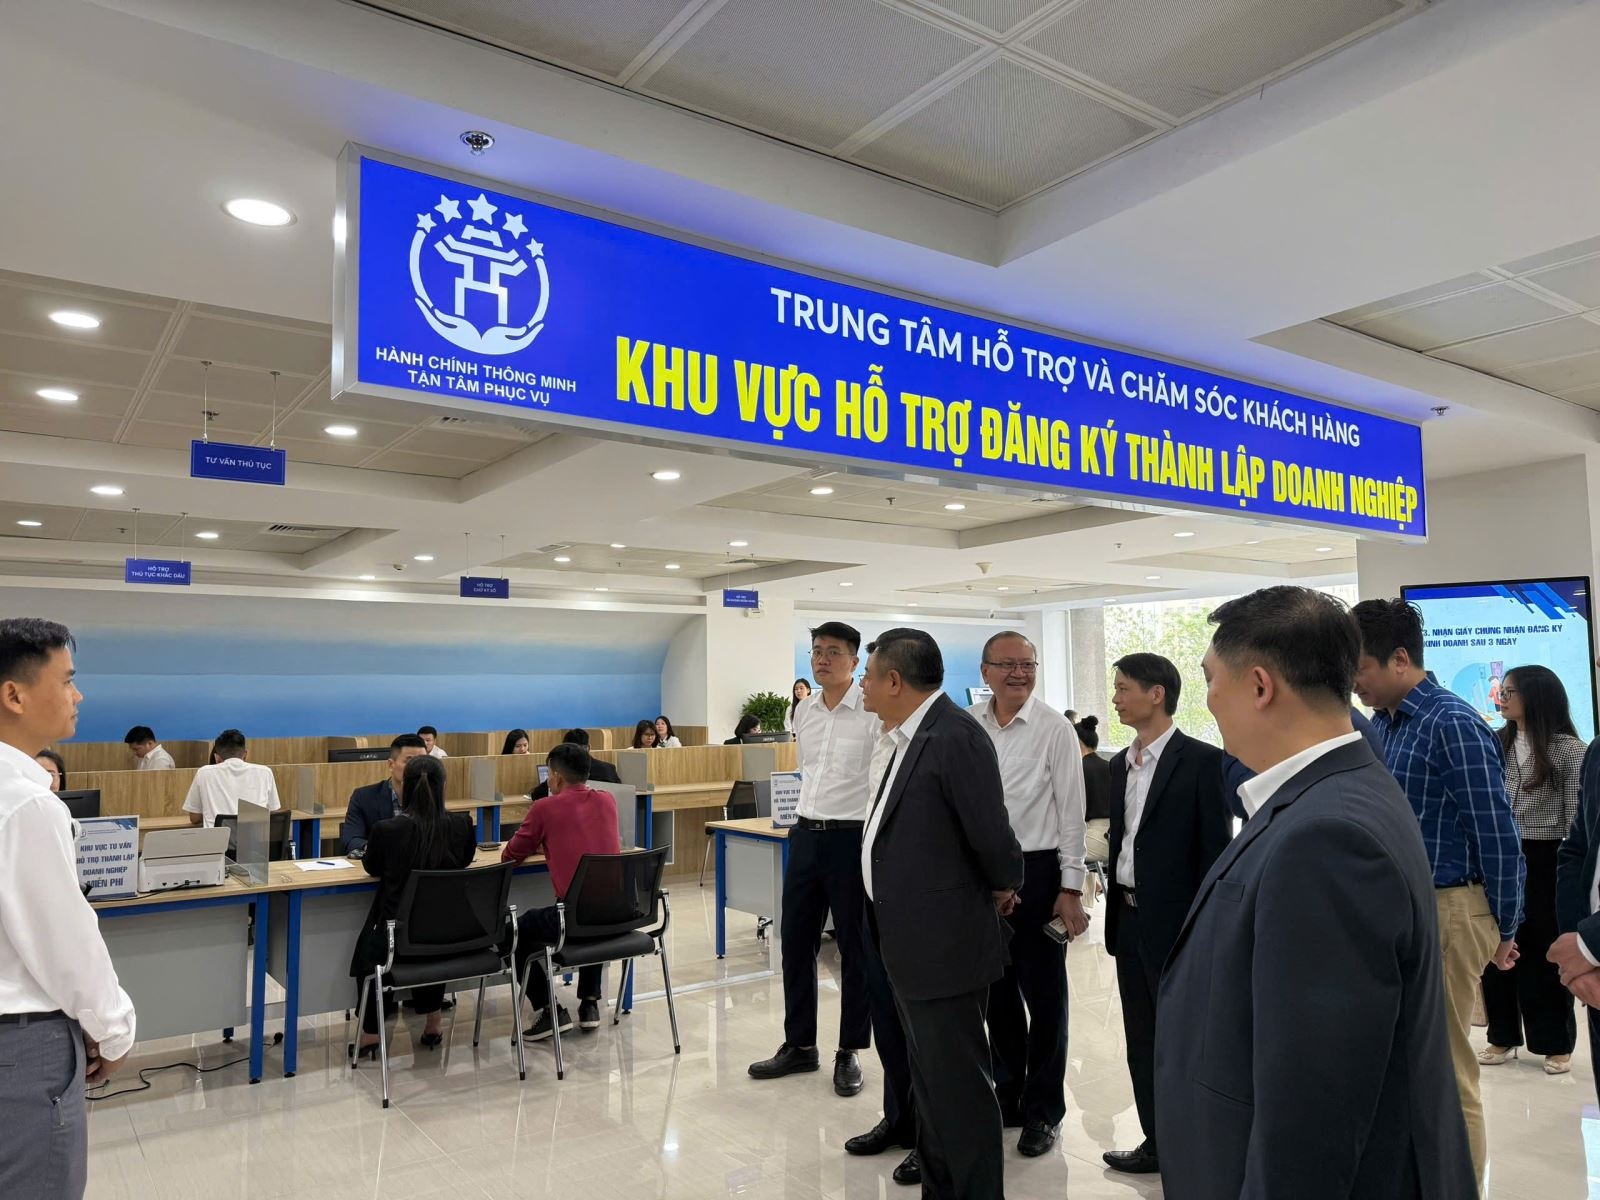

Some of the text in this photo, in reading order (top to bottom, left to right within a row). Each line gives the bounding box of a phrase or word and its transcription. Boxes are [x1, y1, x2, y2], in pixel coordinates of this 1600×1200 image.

[375, 346, 577, 393] HÀNH CHÍNH THÔNG MINH
[770, 286, 1360, 447] TRUNG TÂM HỖ TRỢ VÀ CHĂM SÓC KHÁCH HÀNG
[408, 369, 550, 407] TẬN TÂM PHỤC VỤ
[616, 335, 1418, 530] KHU VỰC HỖ TRỢ ĐĂNG KÝ THÀNH LẬP DOANH NGHIỆP
[205, 456, 272, 470] TƯ VẤN THỦ TỤC
[1442, 639, 1469, 647] DOANH
[1470, 638, 1486, 647] SAU
[1488, 638, 1494, 646] 3
[80, 844, 94, 852] KHU
[83, 868, 104, 876] DOANH
